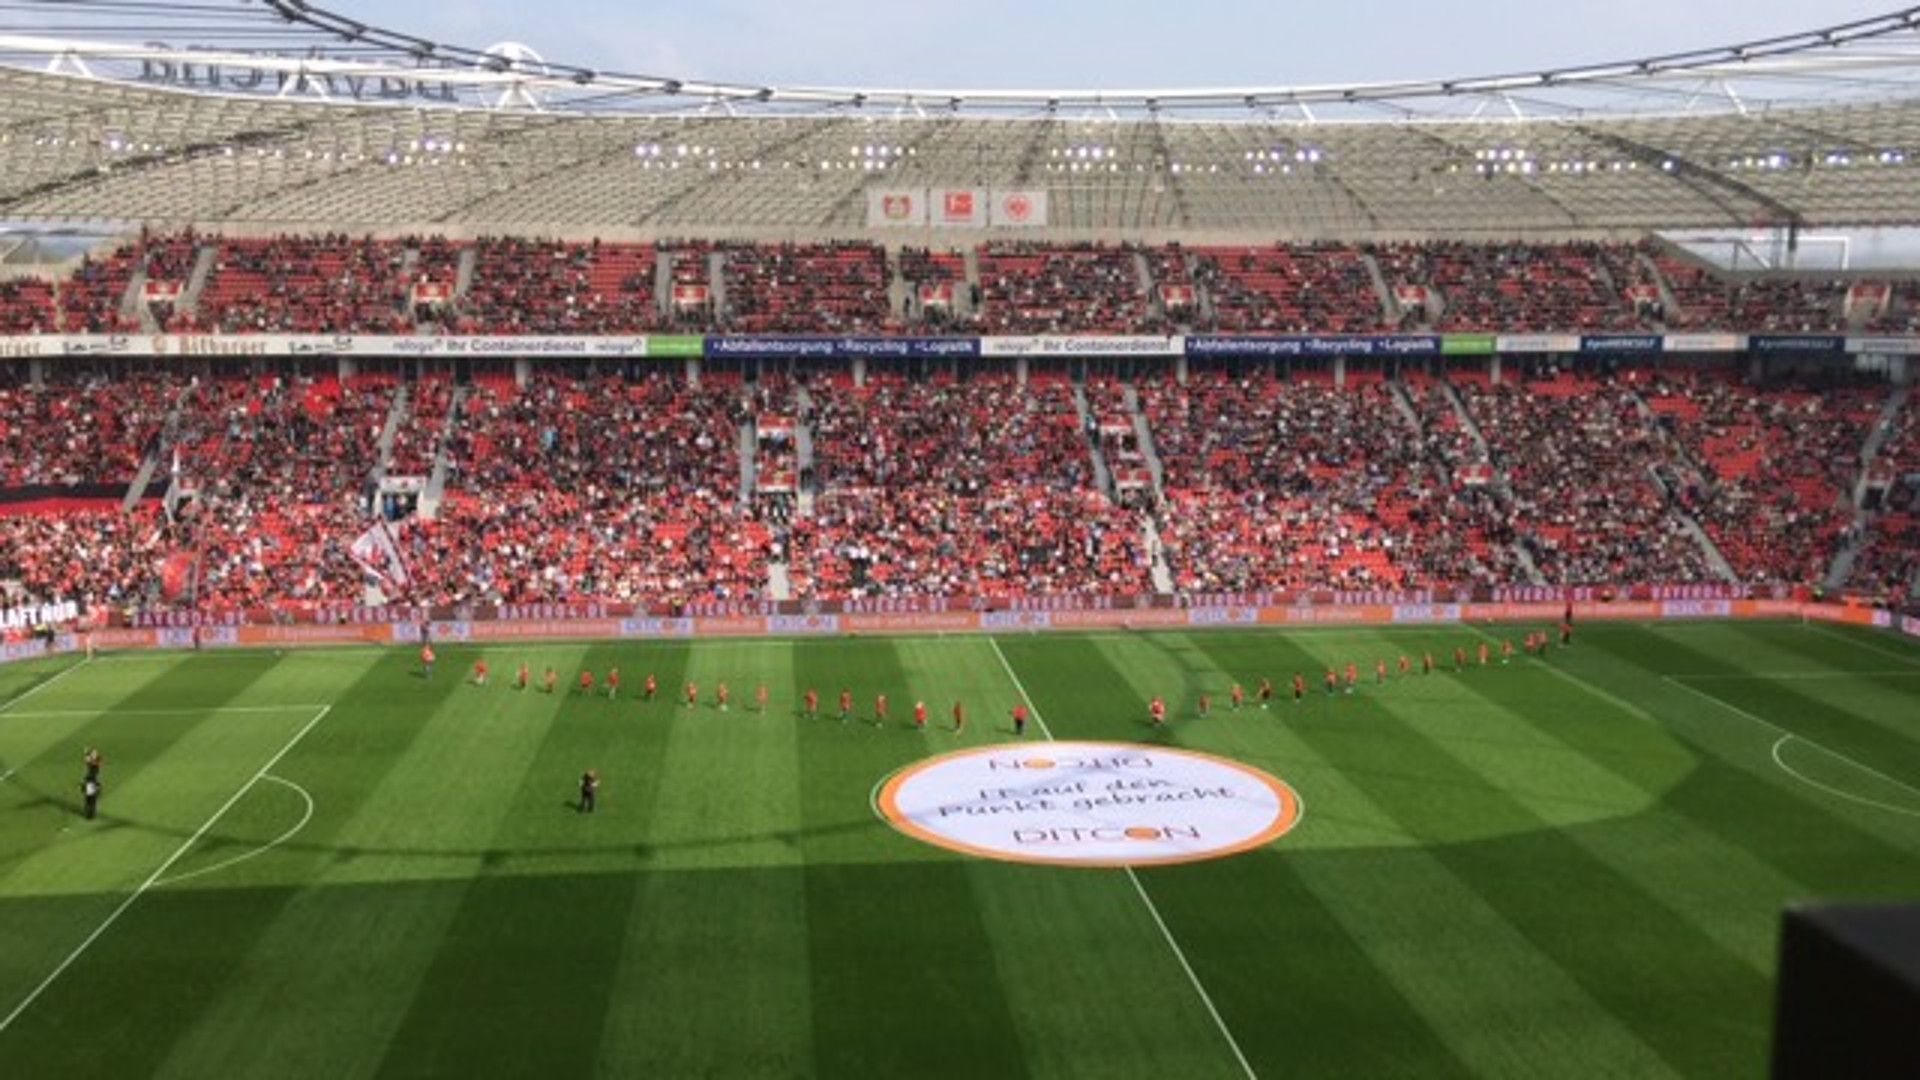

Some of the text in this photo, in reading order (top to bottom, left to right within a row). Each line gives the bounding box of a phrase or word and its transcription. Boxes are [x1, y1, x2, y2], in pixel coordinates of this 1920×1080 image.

[1106, 778, 1172, 791] den
[938, 786, 1236, 818] Punkt gebracht
[1012, 825, 1201, 843] DITCON
